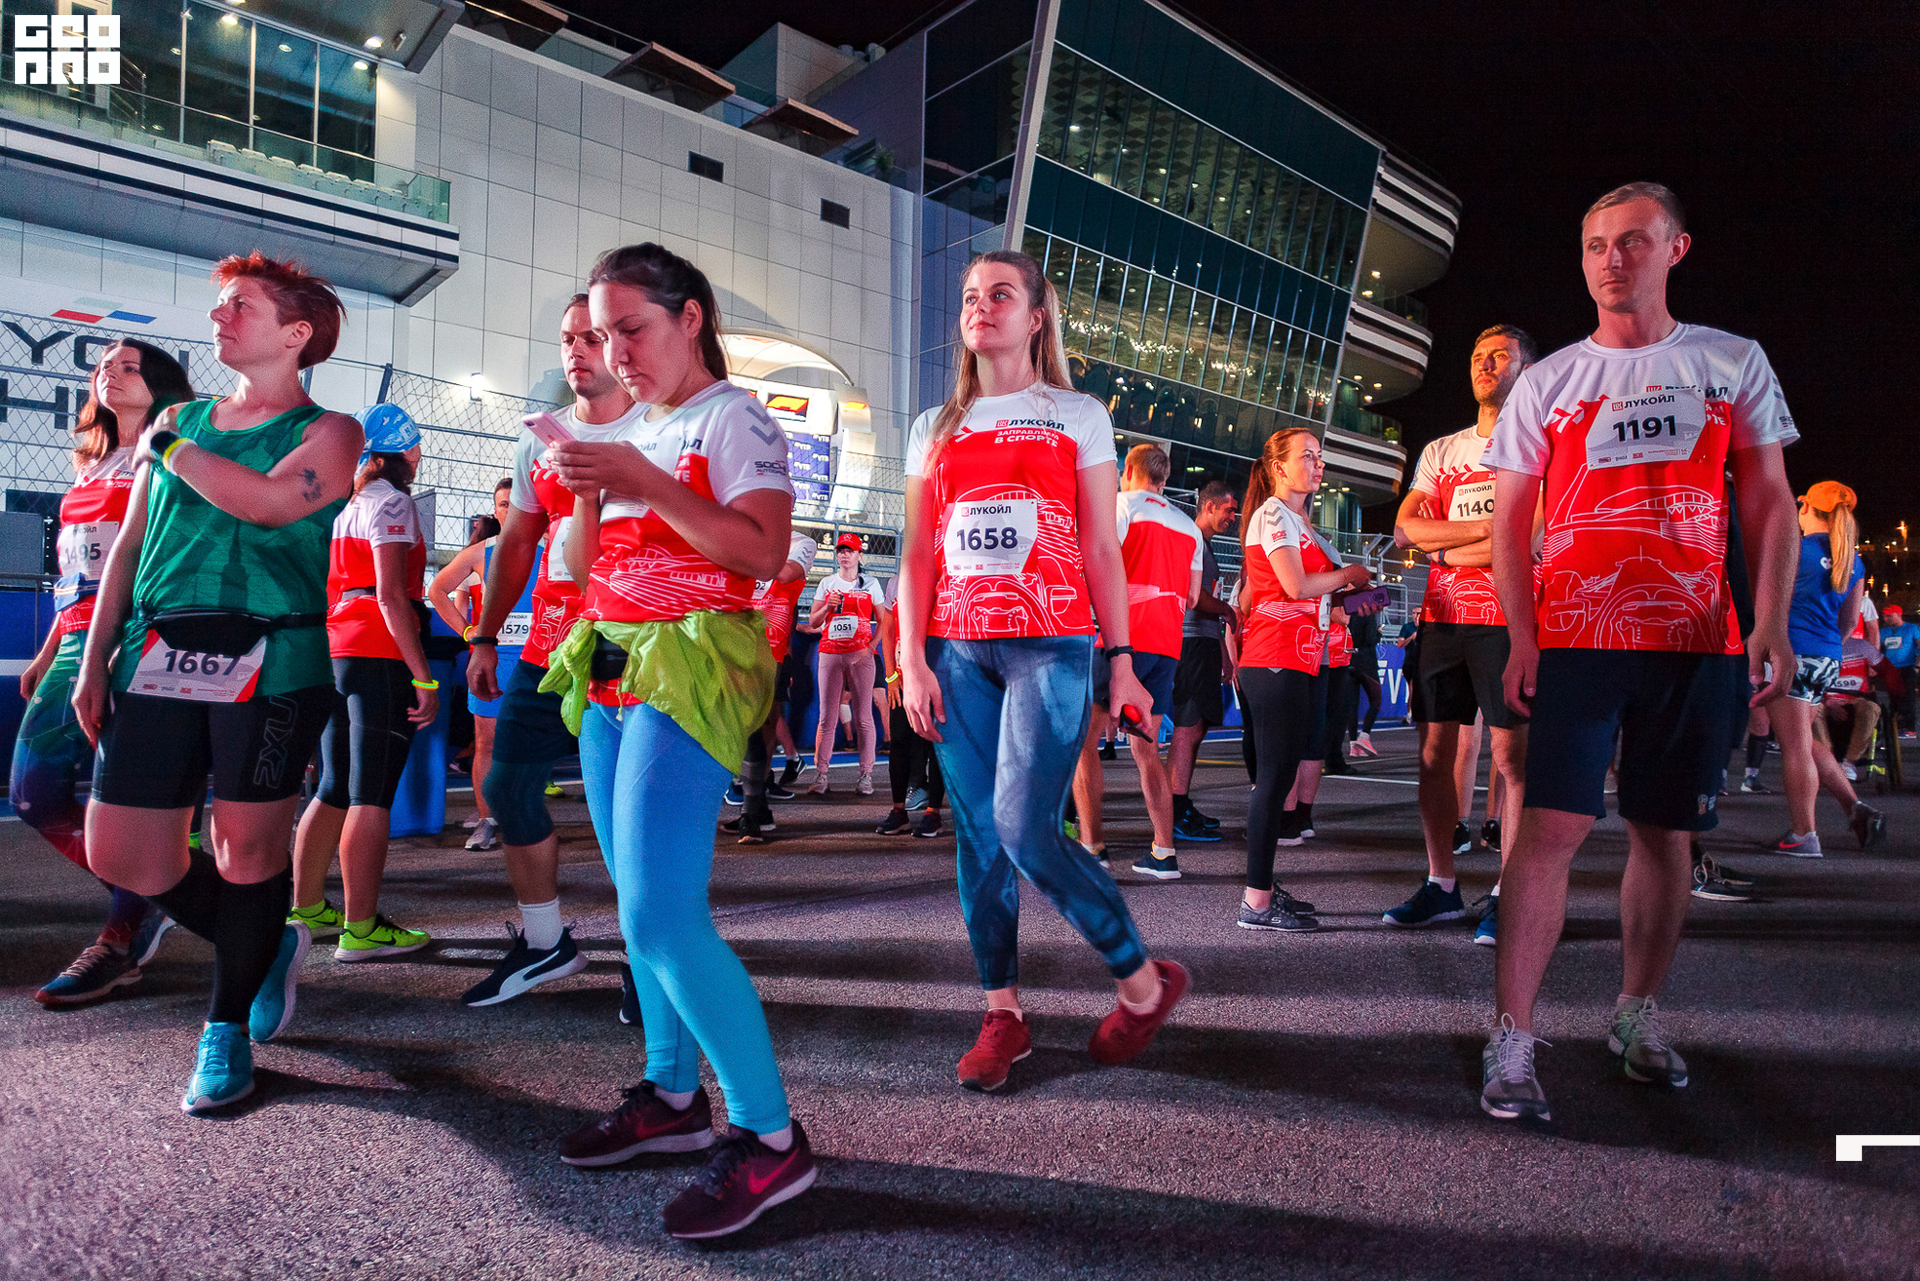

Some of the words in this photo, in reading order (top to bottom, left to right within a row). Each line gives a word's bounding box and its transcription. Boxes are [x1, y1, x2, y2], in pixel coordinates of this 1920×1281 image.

[1624, 395, 1675, 410] ЛУКОЙЛ
[1009, 419, 1065, 431] ЛУКОЙЛ
[1612, 415, 1677, 442] 1191
[994, 436, 1002, 444] В
[1011, 435, 1058, 447] СПОРТЕ
[1464, 485, 1493, 494] ЛУКОЙЛ
[969, 505, 1012, 516] ЛУКОЙЛ
[957, 527, 1018, 551] 1658
[65, 543, 101, 565] 1495
[501, 624, 529, 634] 1579
[833, 624, 852, 632] 1051
[164, 650, 240, 676] 1667
